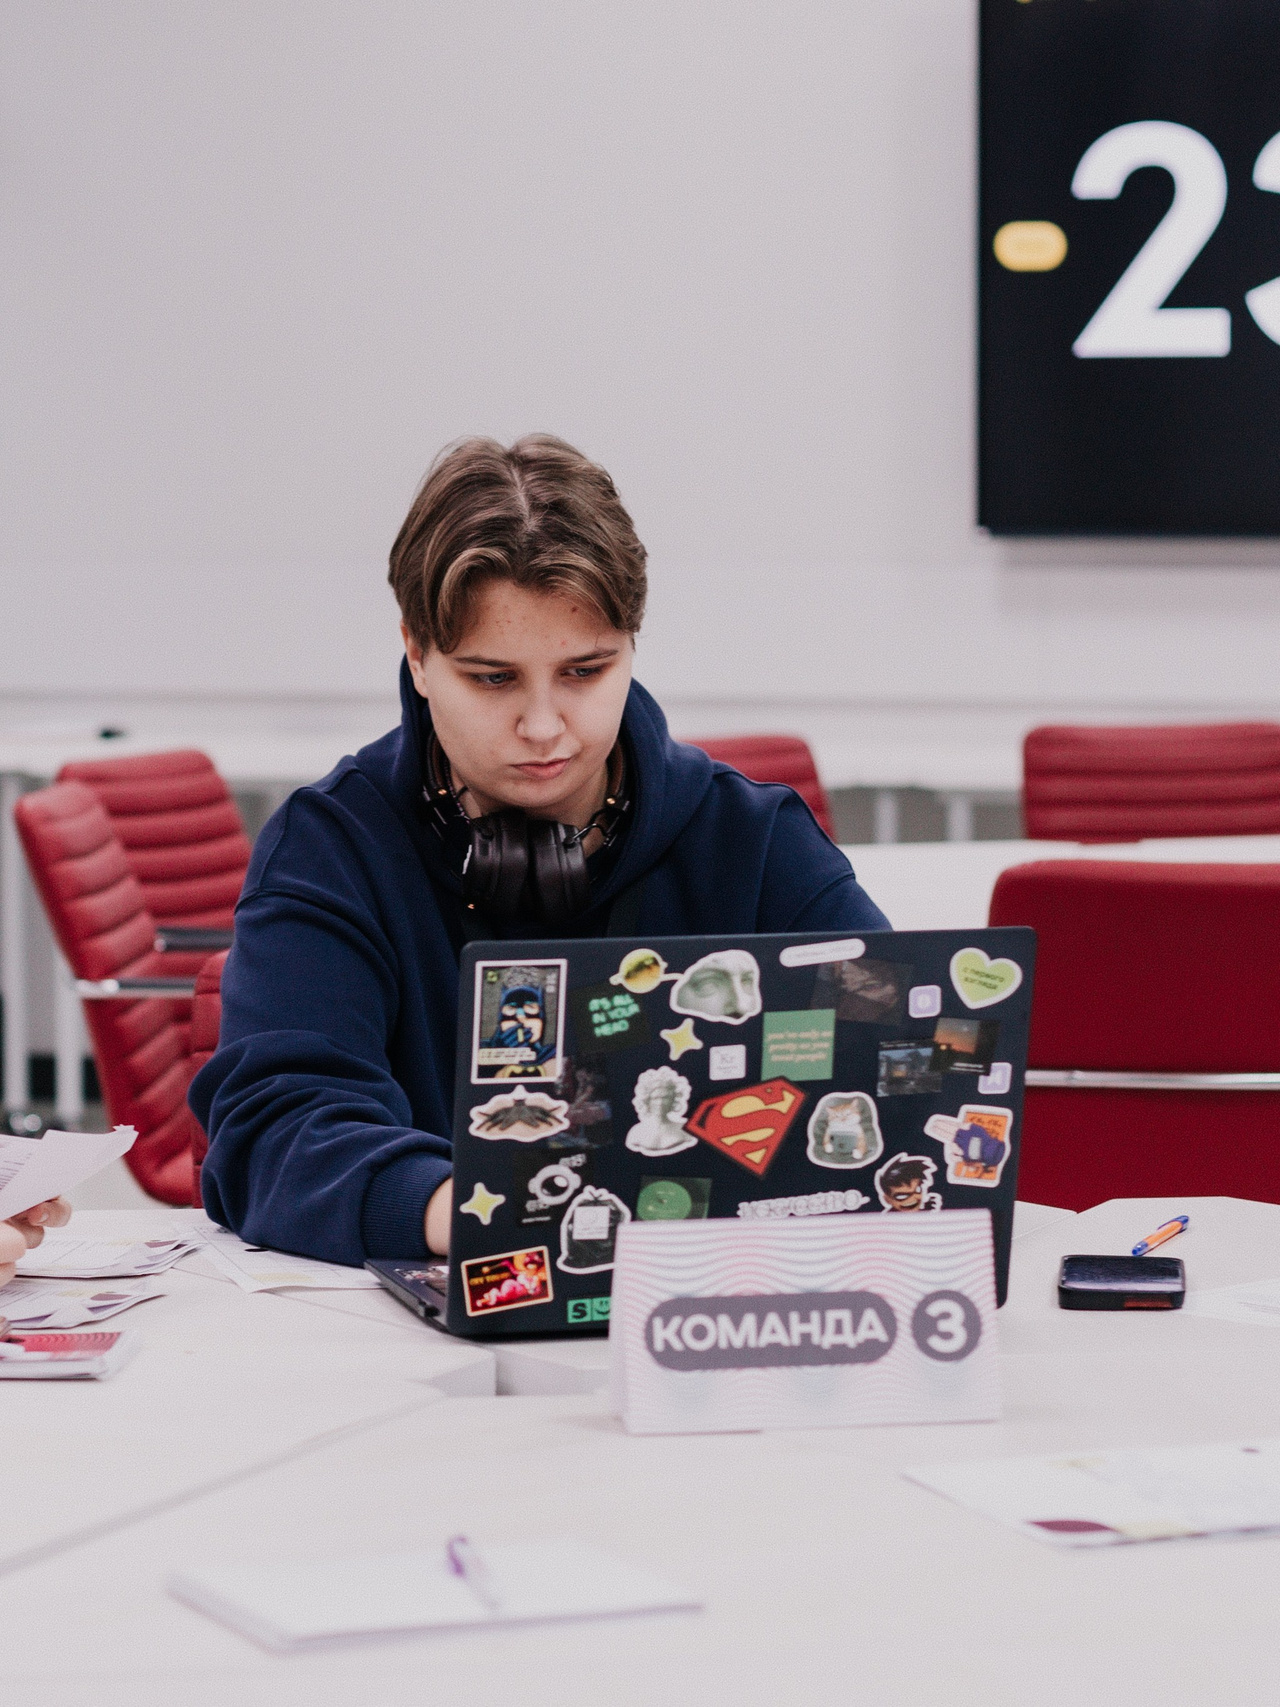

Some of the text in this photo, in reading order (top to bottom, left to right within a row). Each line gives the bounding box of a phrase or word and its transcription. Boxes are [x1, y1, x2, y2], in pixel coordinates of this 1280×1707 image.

[1070, 119, 1280, 360] 2
[594, 1019, 629, 1037] HEAD
[607, 1003, 640, 1020] YOUR
[652, 1299, 968, 1353] КОМАНДА 3
